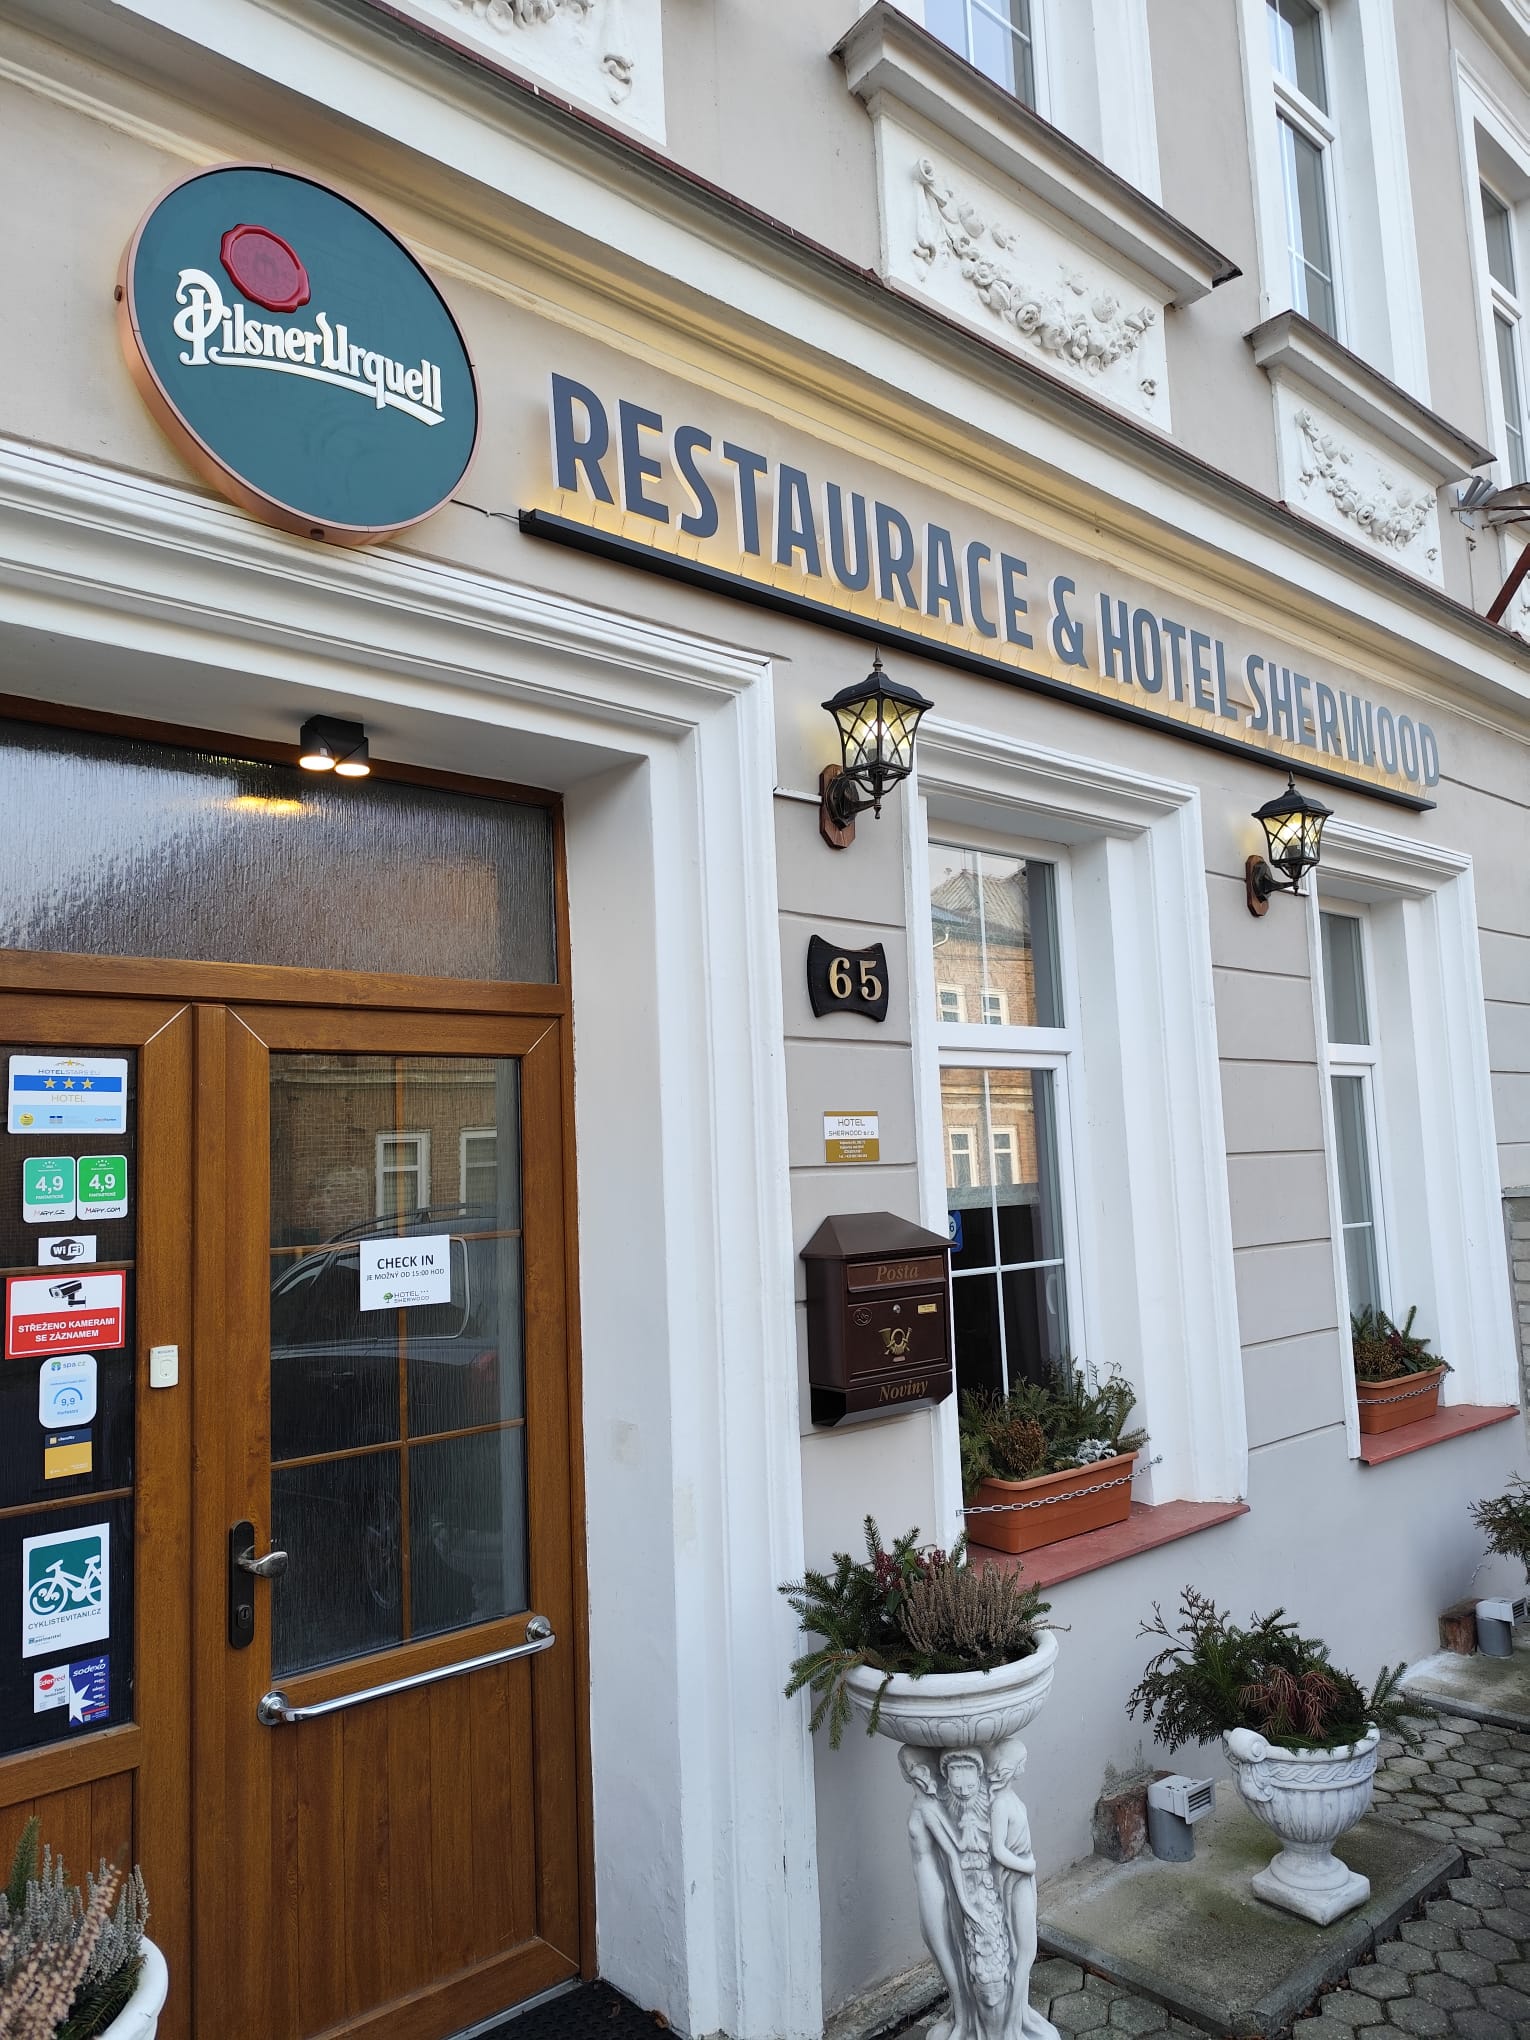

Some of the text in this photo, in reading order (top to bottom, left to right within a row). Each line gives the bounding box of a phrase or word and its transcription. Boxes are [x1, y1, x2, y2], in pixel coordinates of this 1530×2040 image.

[551, 372, 1440, 789] RESTAURACE & HOTEL SHERWOOD
[828, 956, 883, 1001] 65
[51, 1094, 85, 1103] HOTEL
[837, 1118, 866, 1127] HOTEL
[35, 1175, 64, 1194] 4,9
[88, 1173, 116, 1192] 4,9
[377, 1254, 434, 1270] CHECK IN
[412, 1269, 429, 1277] 15:00
[430, 1268, 445, 1276] HOD
[394, 1290, 419, 1298] HOTEL
[18, 1317, 115, 1333] STŘEŽENO KAMERAMI
[35, 1329, 99, 1343] SE ZÁZNAMEM
[879, 1380, 928, 1401] Noviny
[61, 1397, 76, 1407] 9,9
[72, 1659, 106, 1677] sodexo
